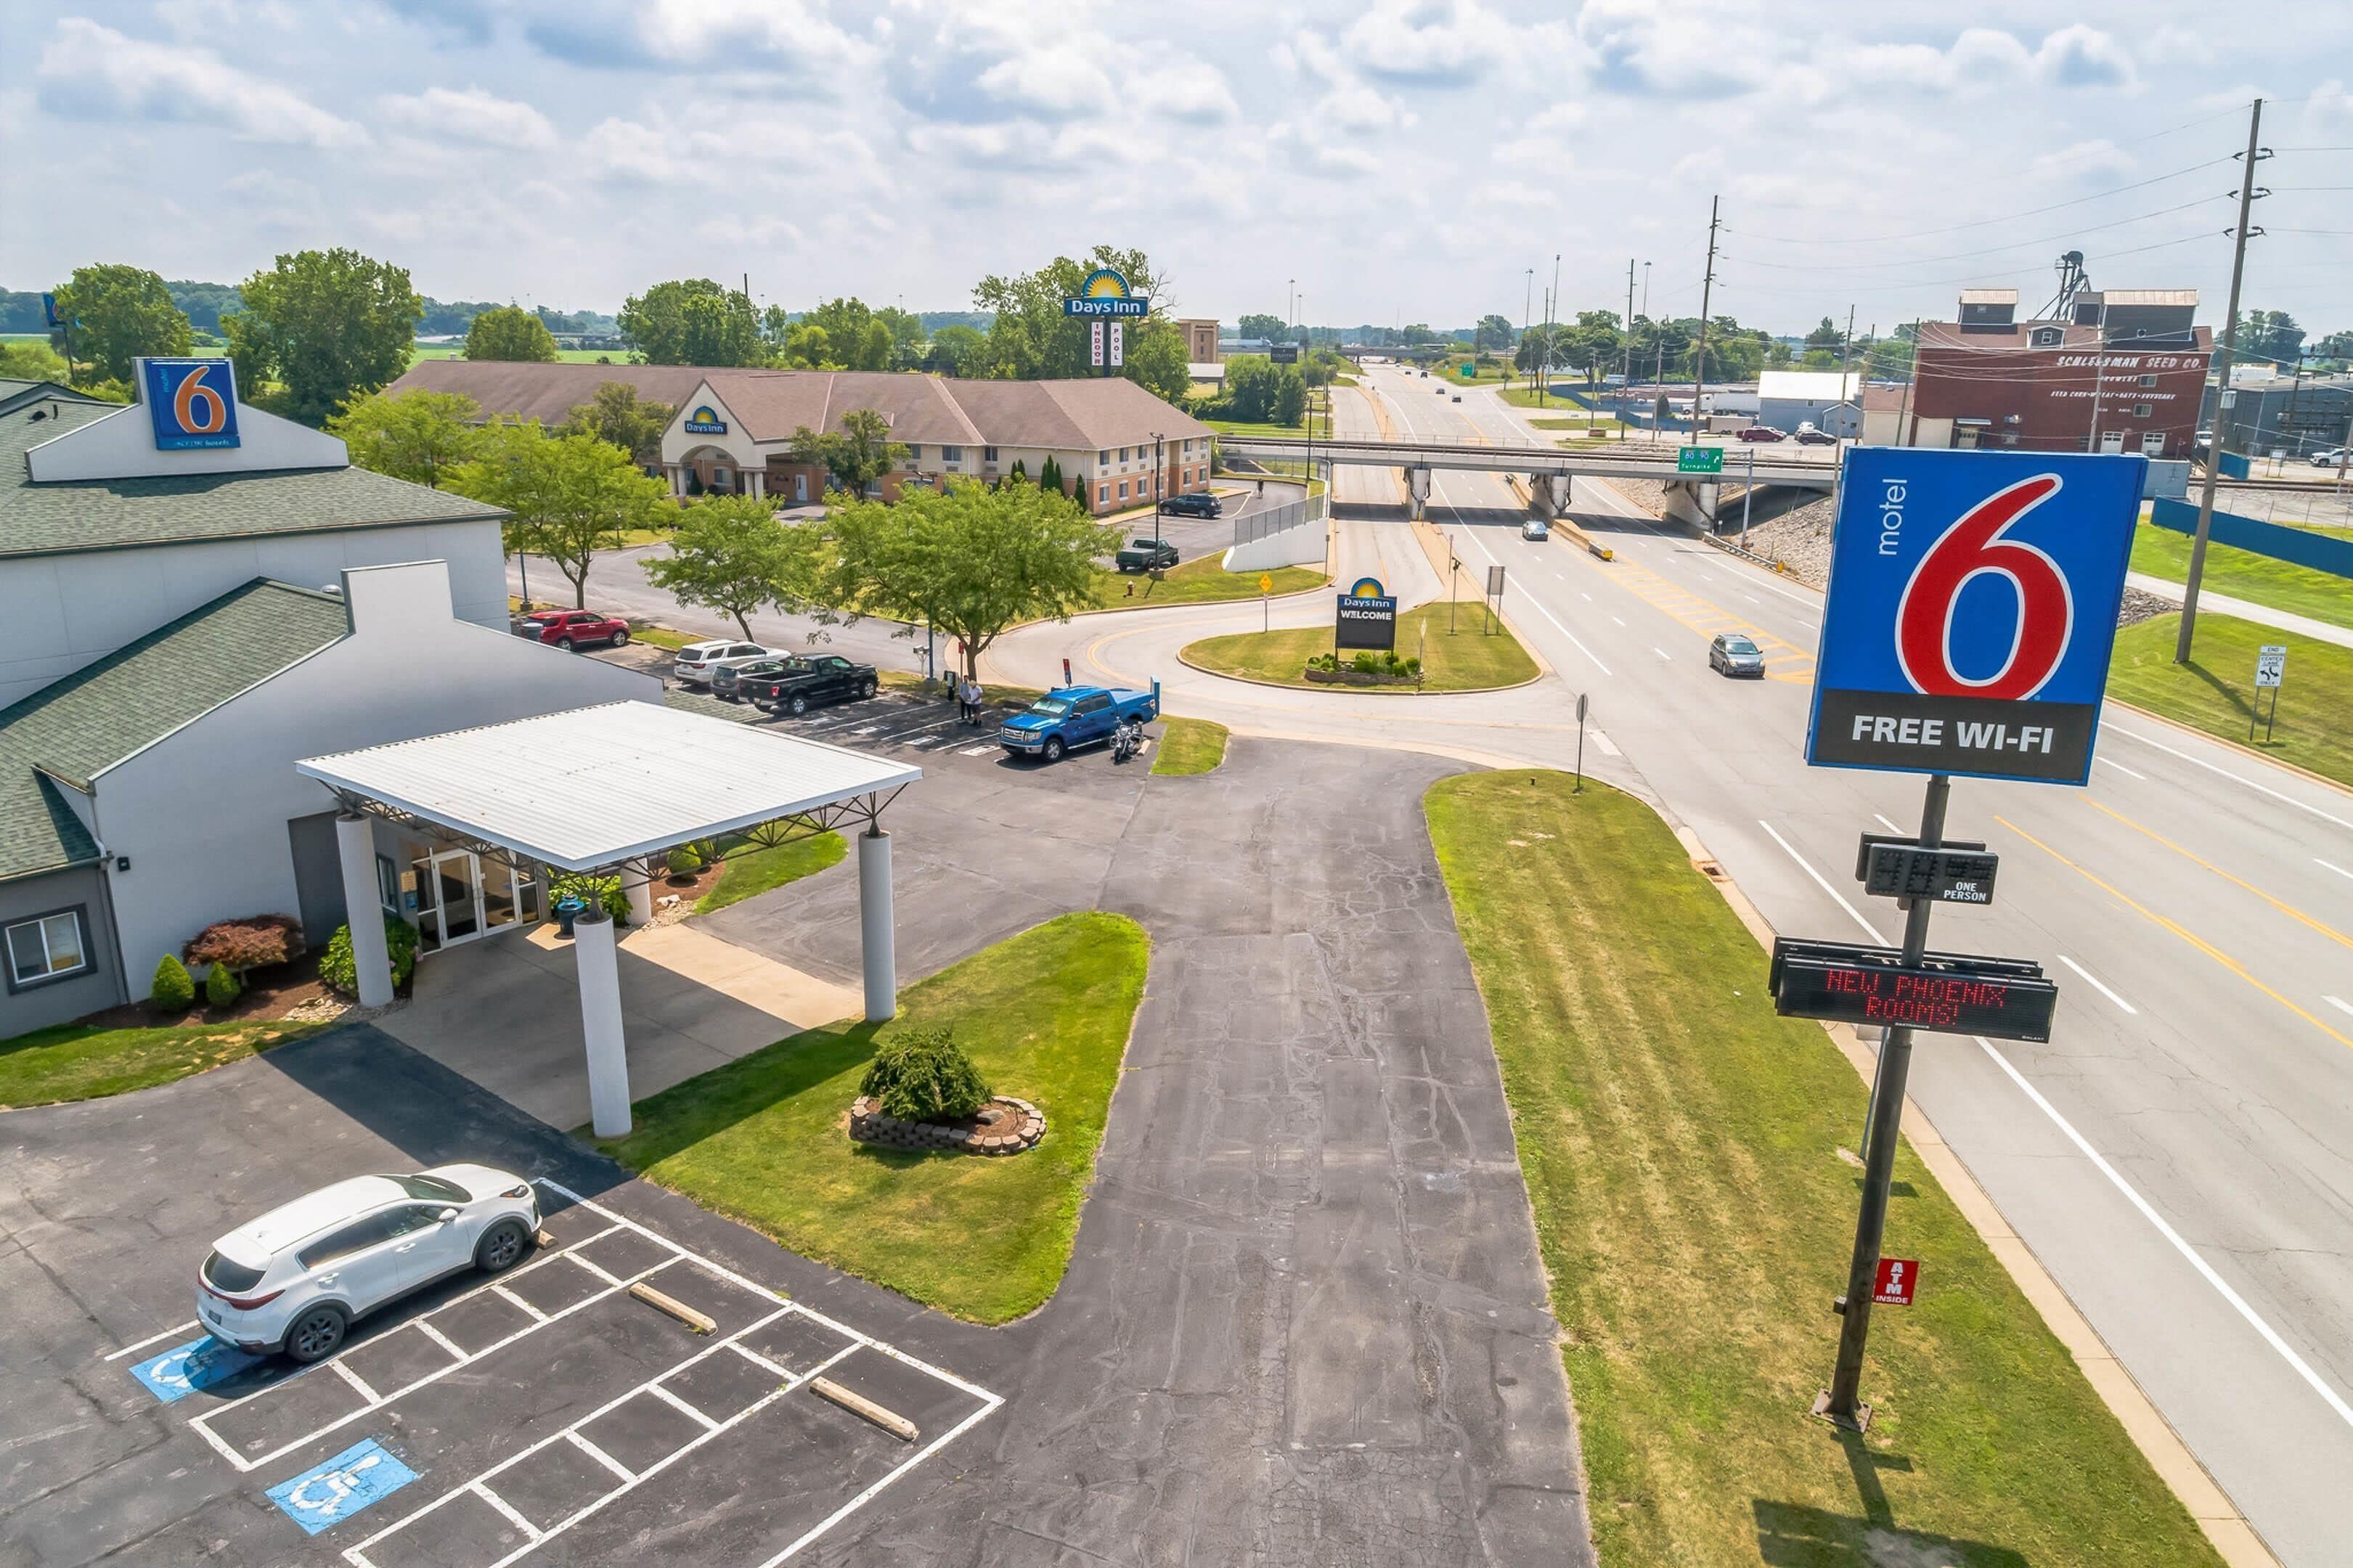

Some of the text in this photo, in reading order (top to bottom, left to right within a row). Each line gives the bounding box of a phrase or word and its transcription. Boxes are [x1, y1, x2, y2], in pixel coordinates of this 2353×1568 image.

[1072, 301, 1141, 314] Days Inn
[2146, 356, 2178, 368] SEED
[2182, 358, 2202, 369] CO.
[174, 365, 227, 434] 6
[686, 423, 724, 433] Days Inn
[1878, 478, 1908, 555] motel
[1894, 473, 2074, 701] 6
[1344, 597, 1390, 608] Days Inn
[1341, 609, 1392, 621] WELCOME
[1852, 715, 2054, 754] FREE WI-FI
[1955, 881, 1978, 892] ONE
[1944, 890, 1986, 902] PERSON
[1827, 969, 2006, 1008] NEW PHOENIX
[1866, 996, 1959, 1026] ROOMS!
[1885, 1262, 1904, 1295] ATM
[1875, 1296, 1909, 1304] INSIDE
